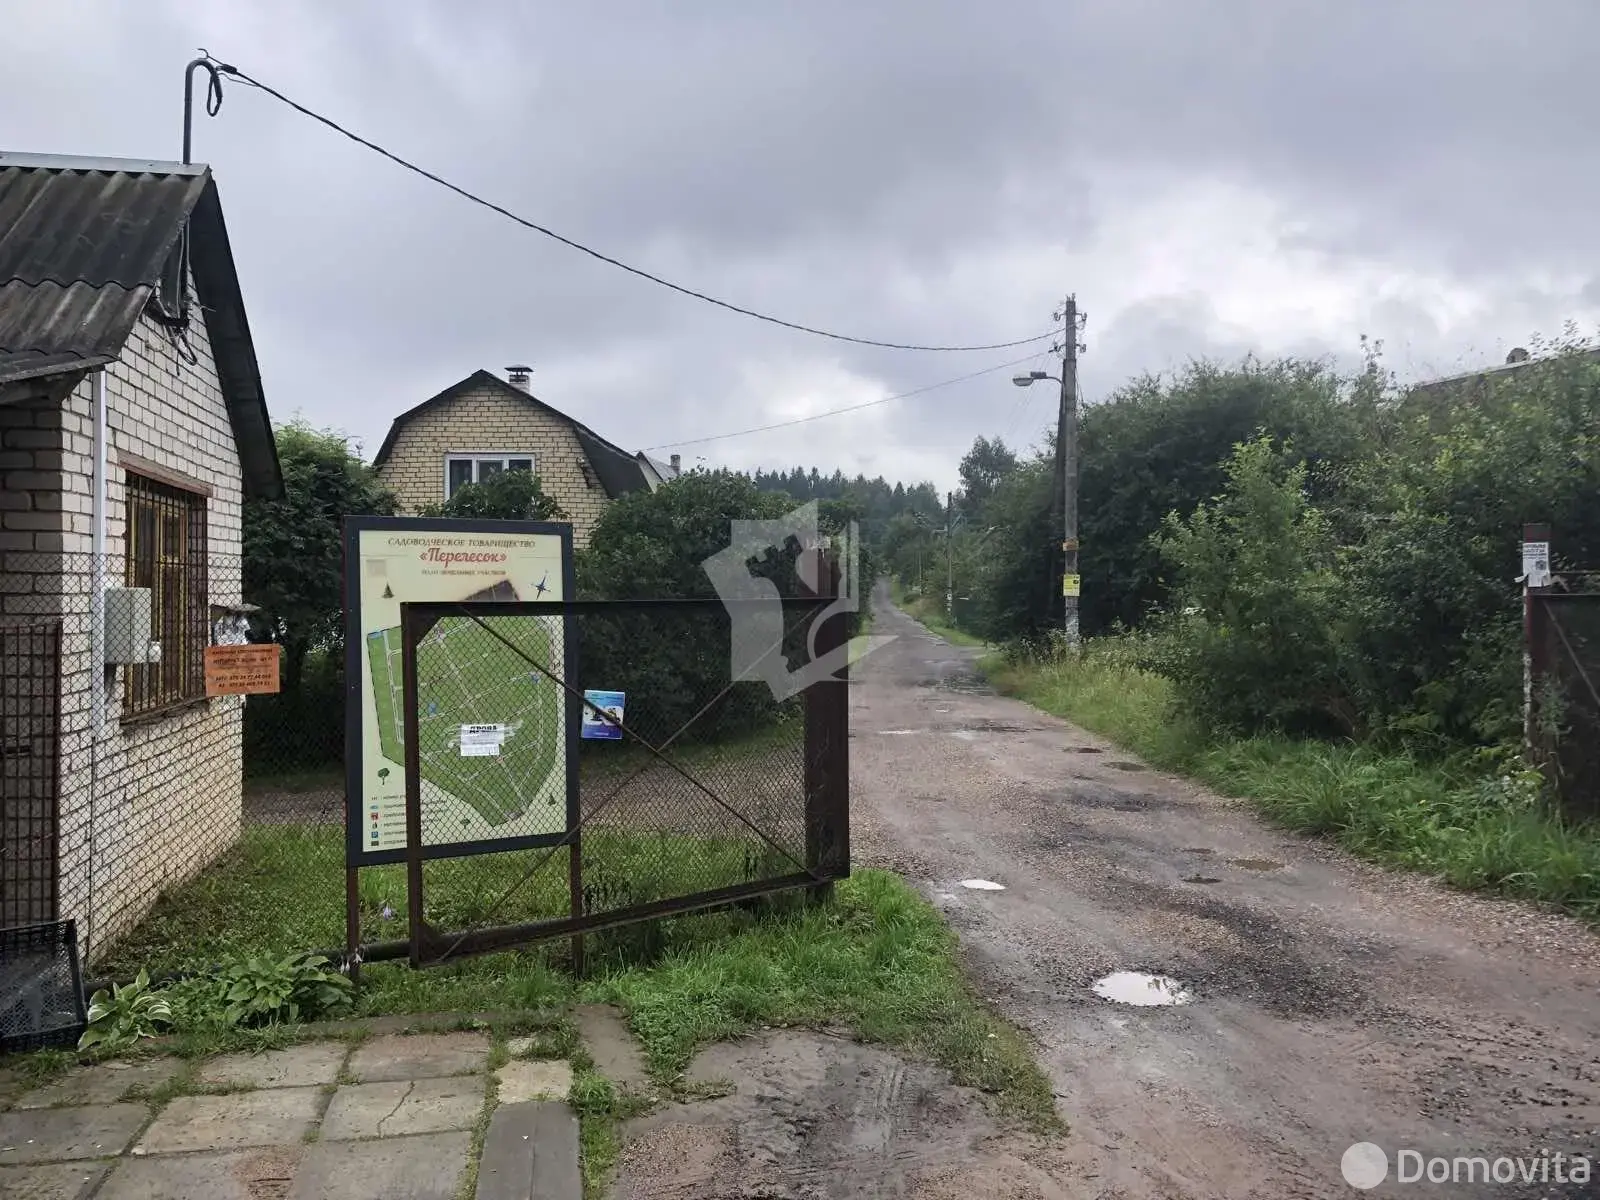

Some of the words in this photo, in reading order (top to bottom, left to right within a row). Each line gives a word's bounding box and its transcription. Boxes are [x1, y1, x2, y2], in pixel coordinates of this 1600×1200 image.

[388, 537, 465, 547] САДОВОДЧЕСКОЕ
[468, 539, 536, 549] ТОВАРИЩЕСТВО
[419, 547, 507, 568] «Перелесок»
